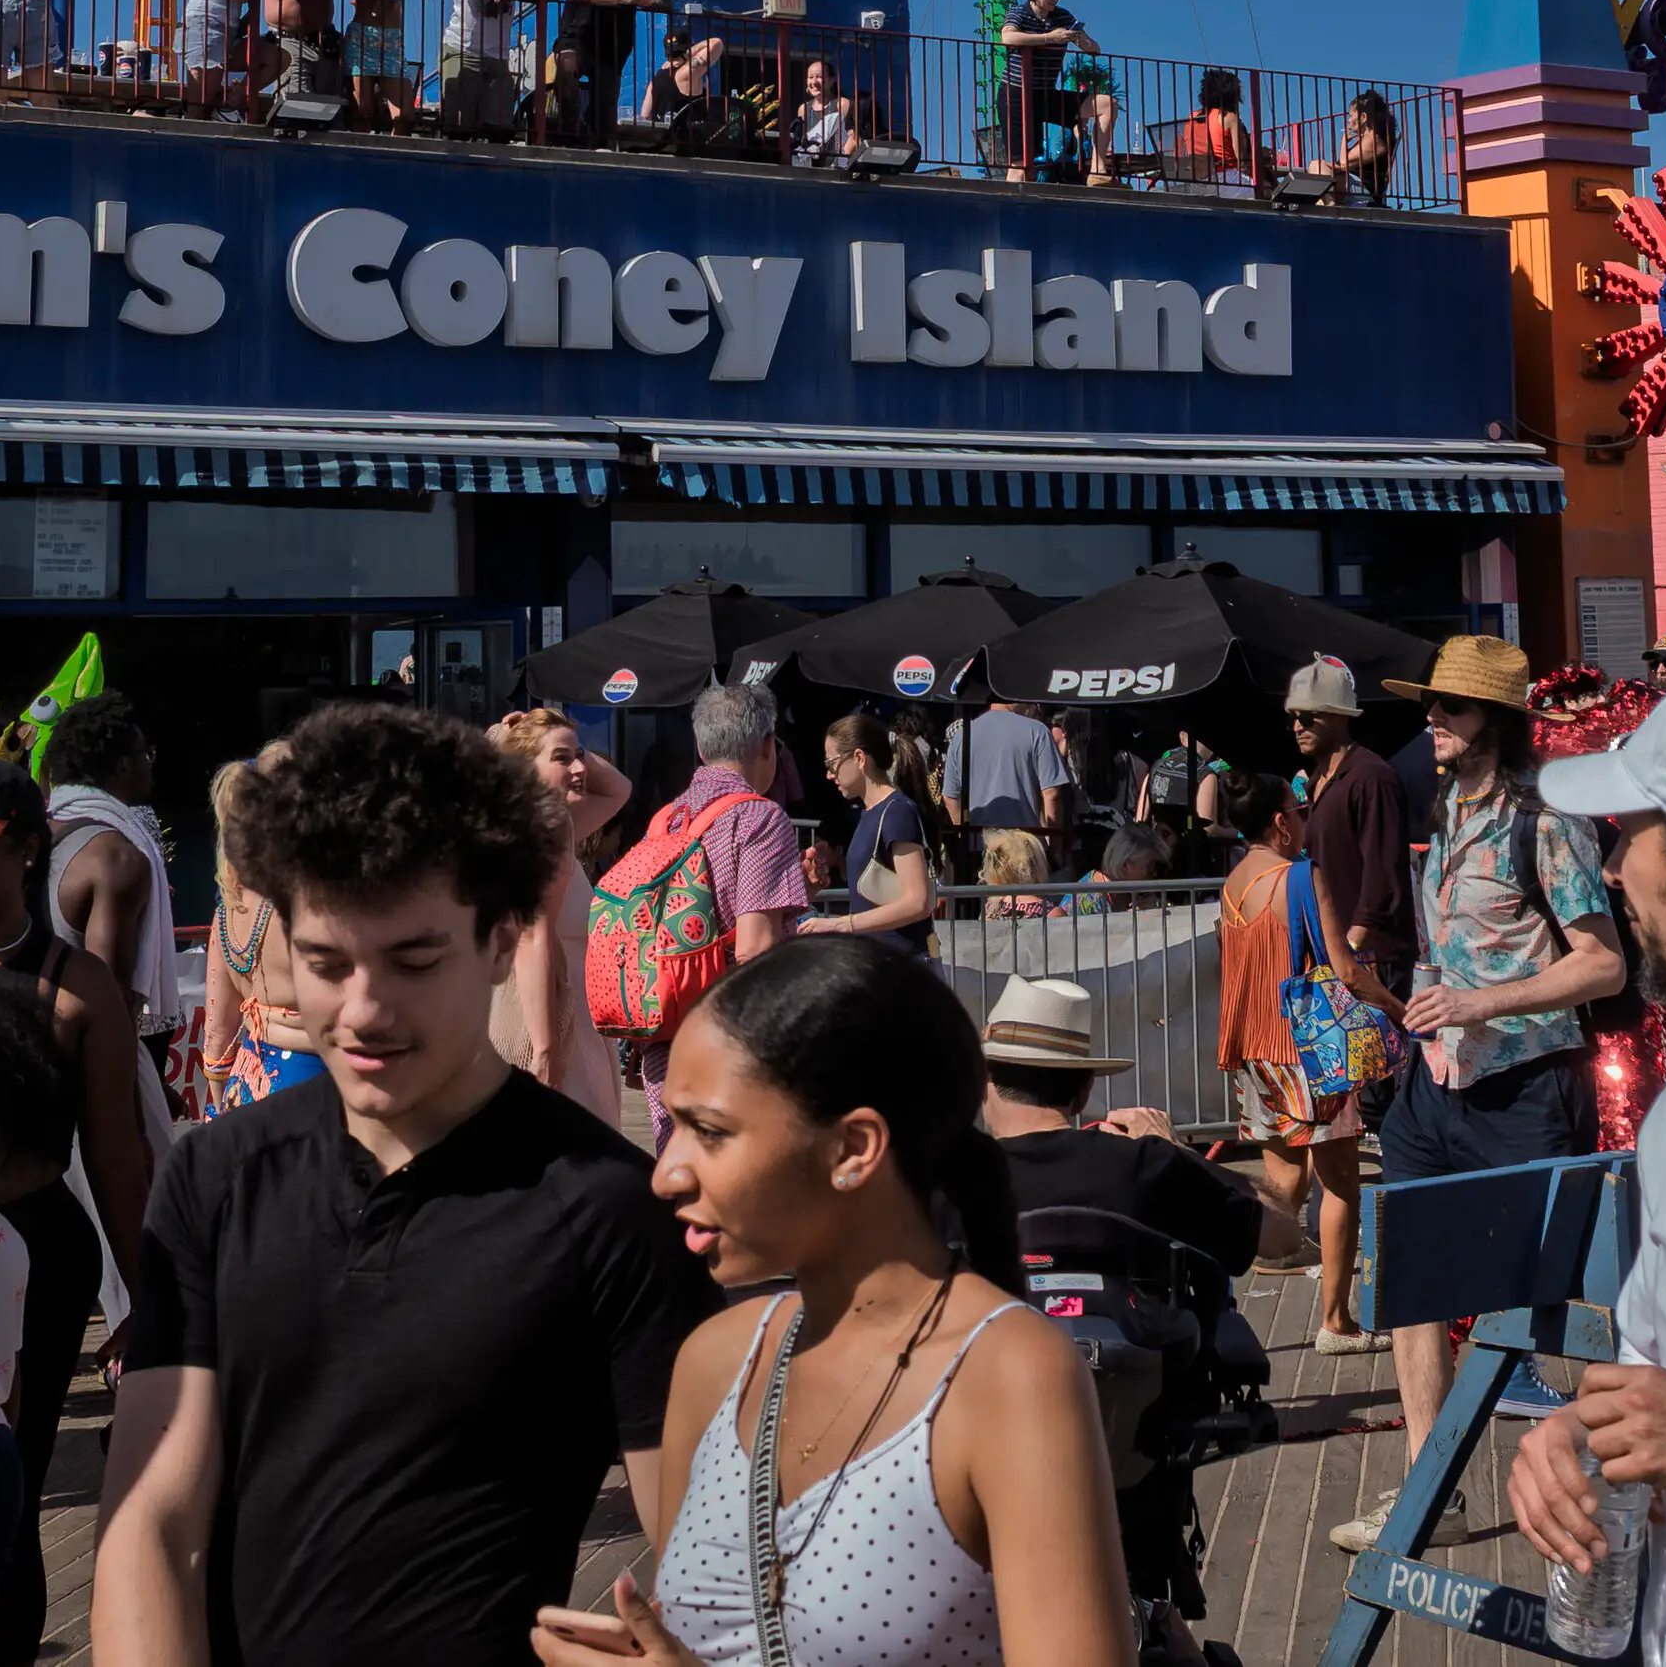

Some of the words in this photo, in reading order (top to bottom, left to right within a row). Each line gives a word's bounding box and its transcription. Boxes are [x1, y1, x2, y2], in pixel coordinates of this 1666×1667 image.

[286, 207, 804, 381] Coney
[850, 240, 1292, 376] Island
[896, 670, 932, 682] PEPSI
[1046, 662, 1176, 698] PEPSI
[1386, 1561, 1492, 1631] POLICE
[1503, 1596, 1549, 1647] DE
